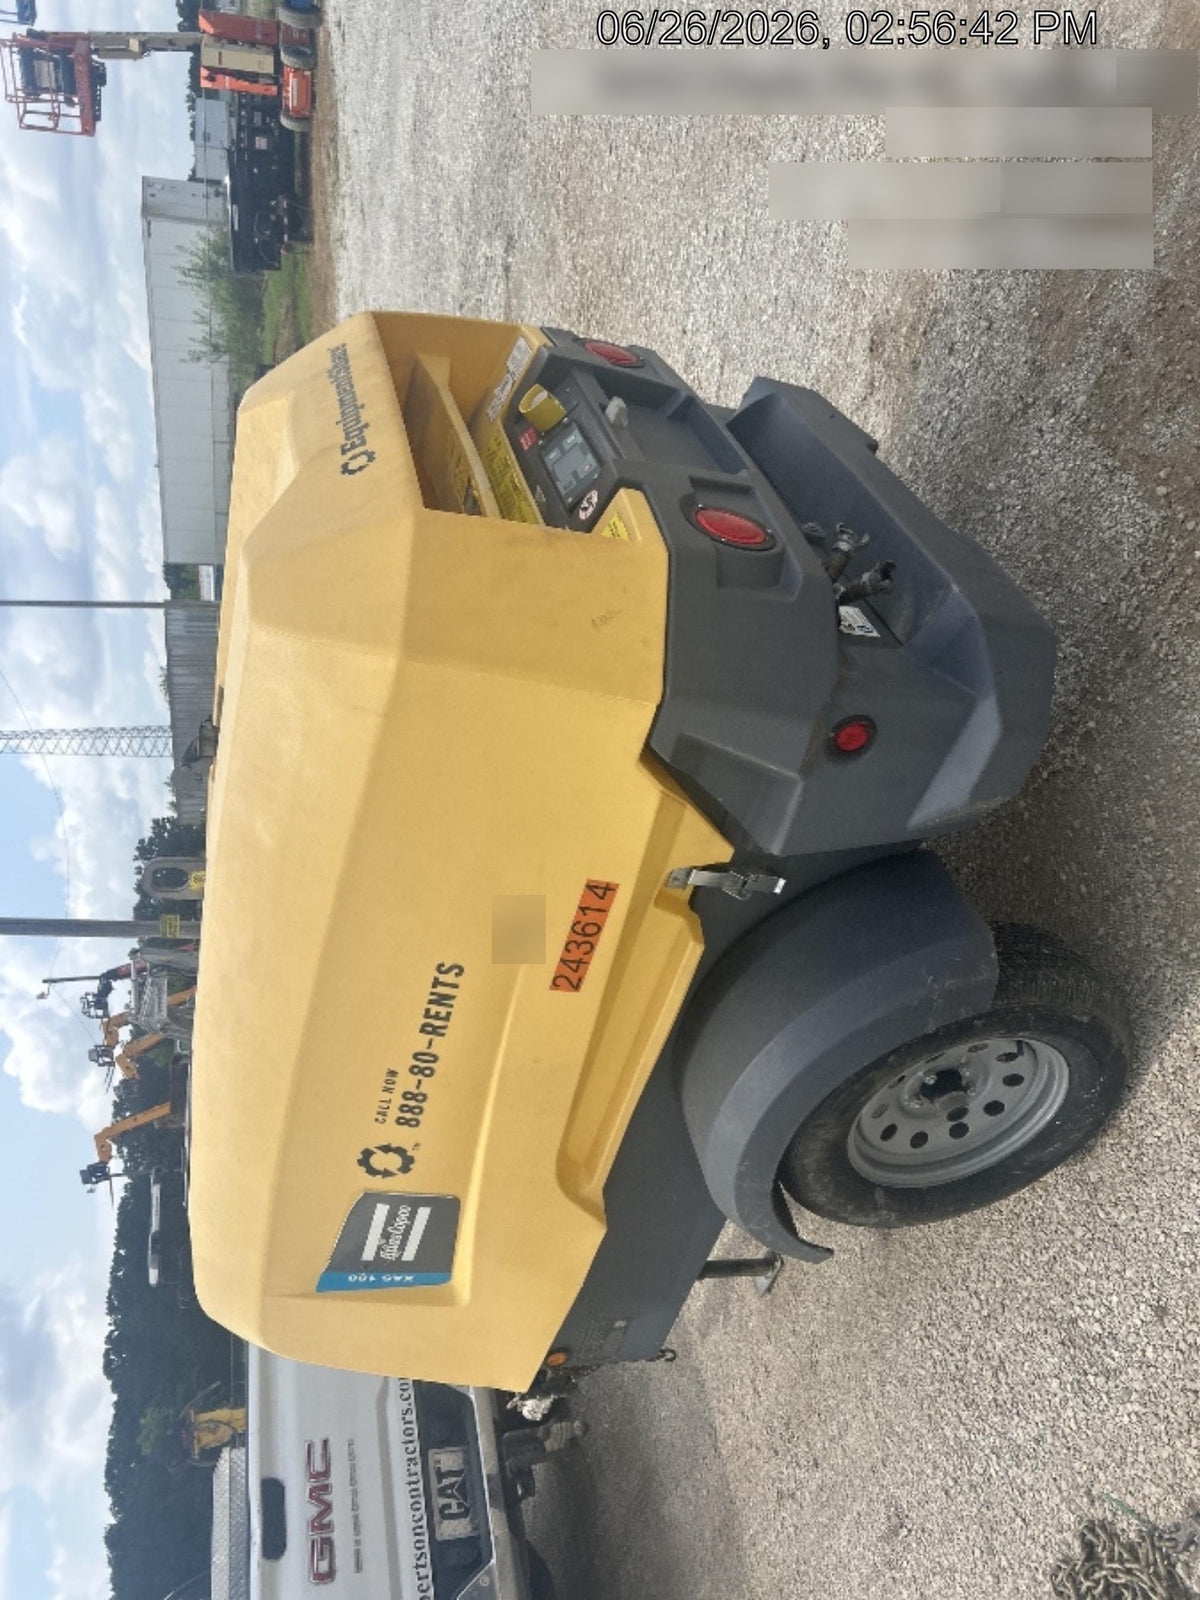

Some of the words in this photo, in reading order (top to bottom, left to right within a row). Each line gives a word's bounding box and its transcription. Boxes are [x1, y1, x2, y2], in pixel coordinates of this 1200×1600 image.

[326, 343, 369, 456] EquipmentShare
[551, 882, 615, 992] 243614
[381, 1068, 399, 1094] NOW
[394, 962, 464, 1128] 888-80-RENTS
[374, 1098, 392, 1125] CALL
[304, 1438, 337, 1585] GMC
[434, 1468, 470, 1521] CAT
